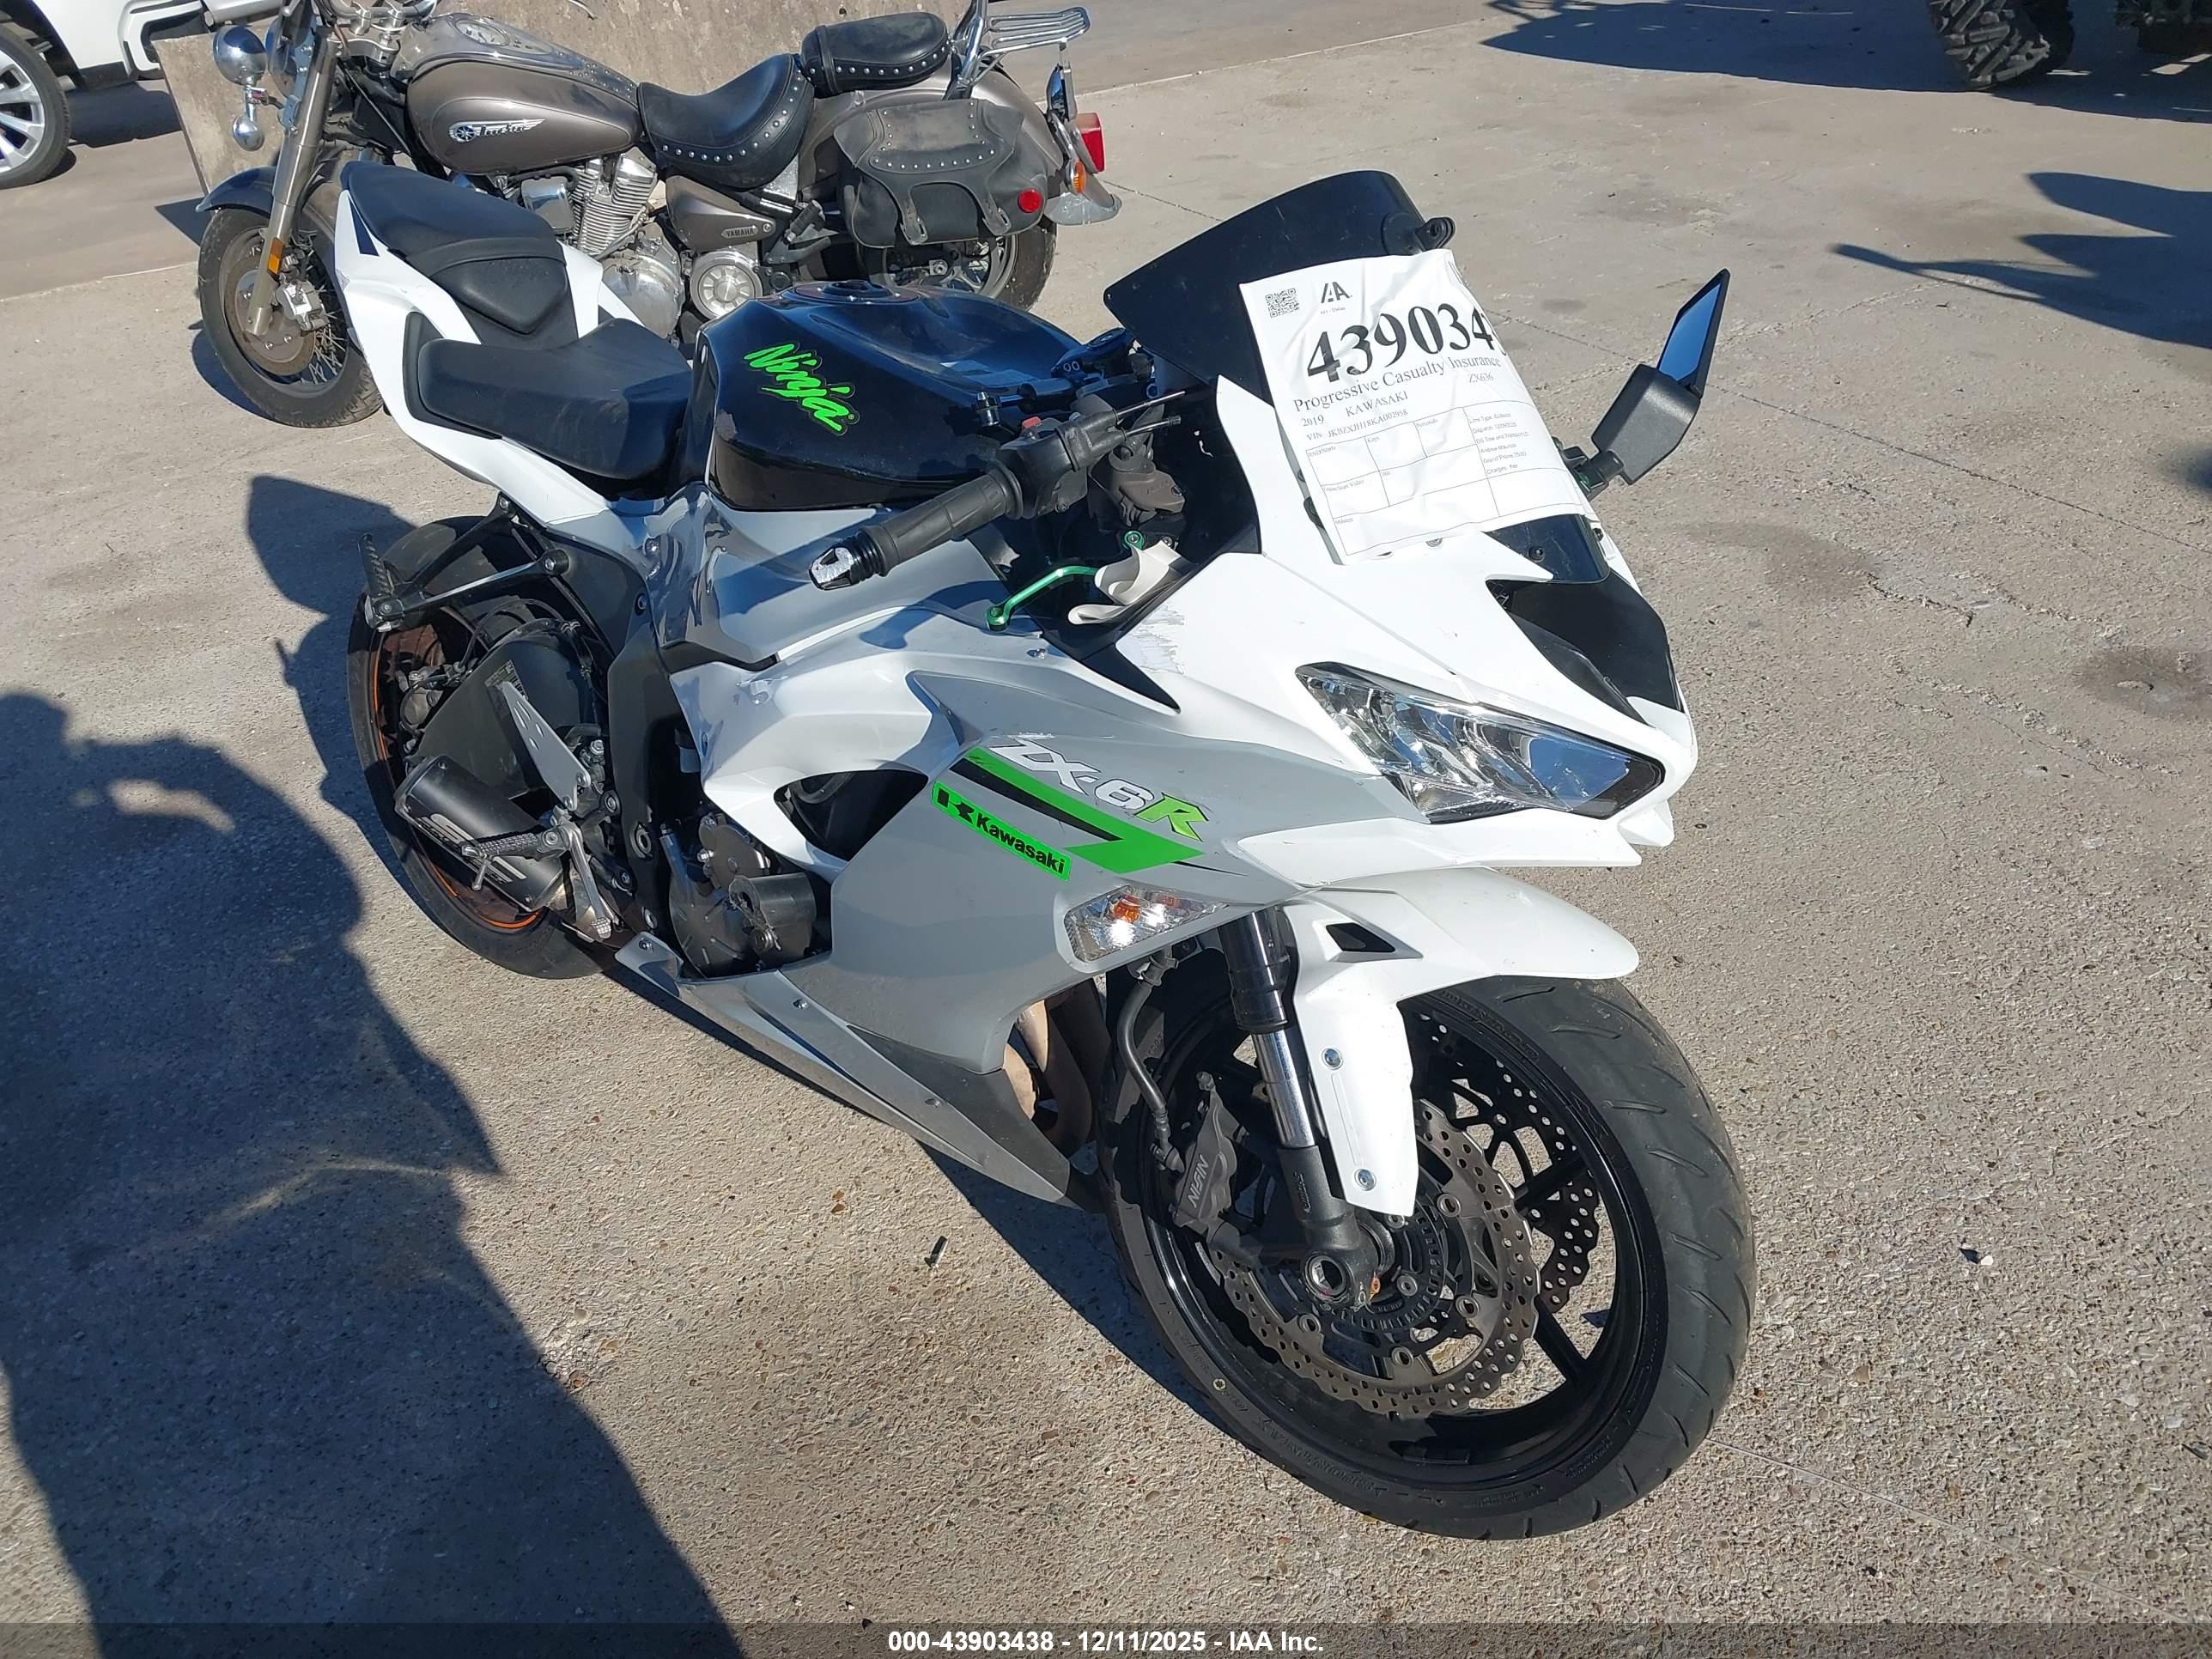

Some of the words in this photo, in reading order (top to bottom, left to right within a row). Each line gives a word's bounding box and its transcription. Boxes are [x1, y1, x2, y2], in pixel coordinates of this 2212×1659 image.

[726, 227, 755, 238] YAMAHA
[1306, 303, 1506, 383] 439034
[743, 343, 850, 432] Ninja
[1293, 379, 1379, 412] Progressive
[1382, 361, 1444, 386] Casualty
[1448, 356, 1502, 369] Insurance
[1301, 414, 1325, 428] 2019
[1346, 391, 1409, 417] KAWASAKI
[988, 735, 1210, 843] ZX-6R
[976, 812, 1066, 874] Kawasaki
